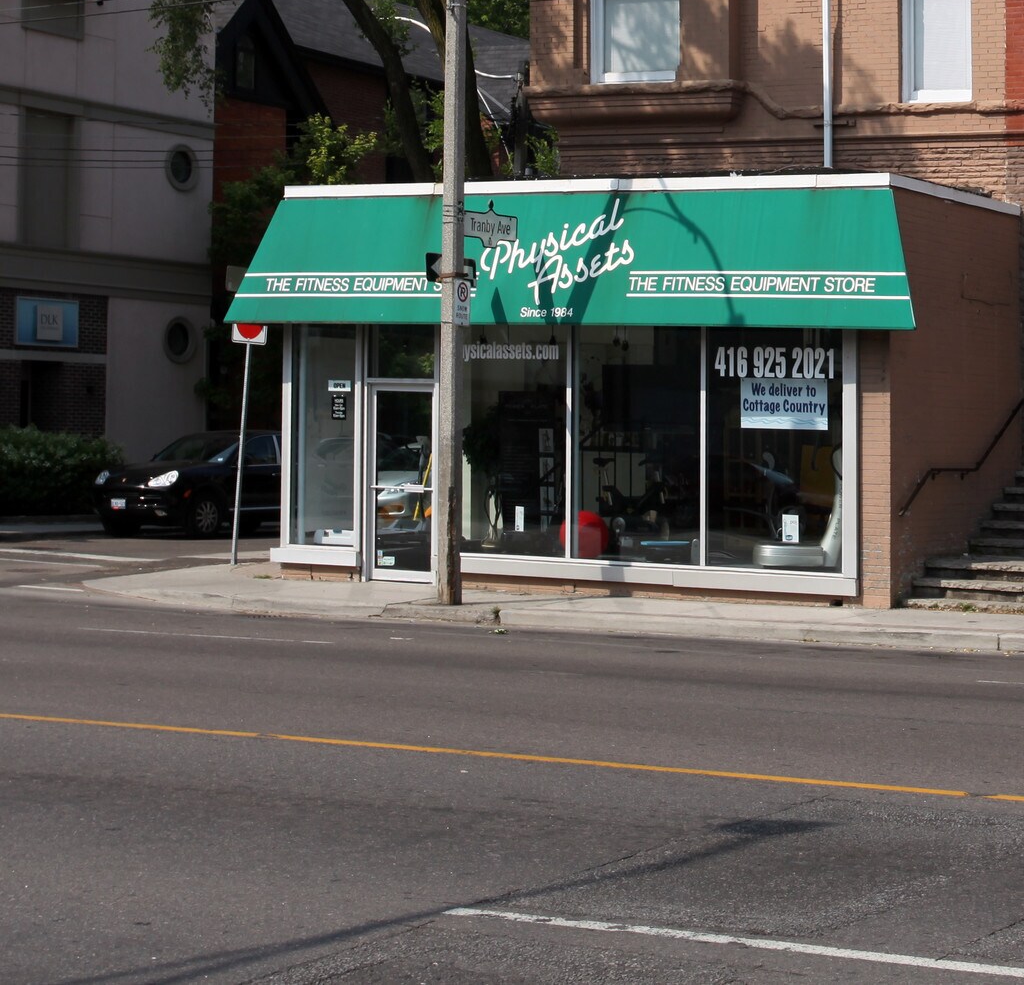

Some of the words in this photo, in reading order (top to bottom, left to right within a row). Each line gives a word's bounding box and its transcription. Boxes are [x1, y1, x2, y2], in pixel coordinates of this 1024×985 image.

[470, 217, 495, 236] Tranby
[497, 220, 511, 235] Ave
[481, 198, 624, 280] Physical
[527, 239, 635, 306] Assets
[266, 279, 291, 291] THE
[295, 279, 349, 291] FITNESS
[353, 278, 428, 292] EQUIPMENT
[629, 276, 657, 291] THE
[662, 277, 725, 291] FITNESS
[731, 277, 820, 293] EQUIPMENT
[823, 278, 876, 293] STORE
[41, 314, 58, 325] DLK
[520, 307, 547, 318] Since
[551, 307, 573, 318] 1984
[714, 346, 748, 377] 416
[753, 347, 786, 378] 925
[792, 347, 835, 379] 2021
[751, 383, 766, 397] We
[768, 383, 802, 397] deliver
[806, 385, 817, 398] to
[743, 399, 780, 414] Cottage
[783, 400, 826, 416] Country
